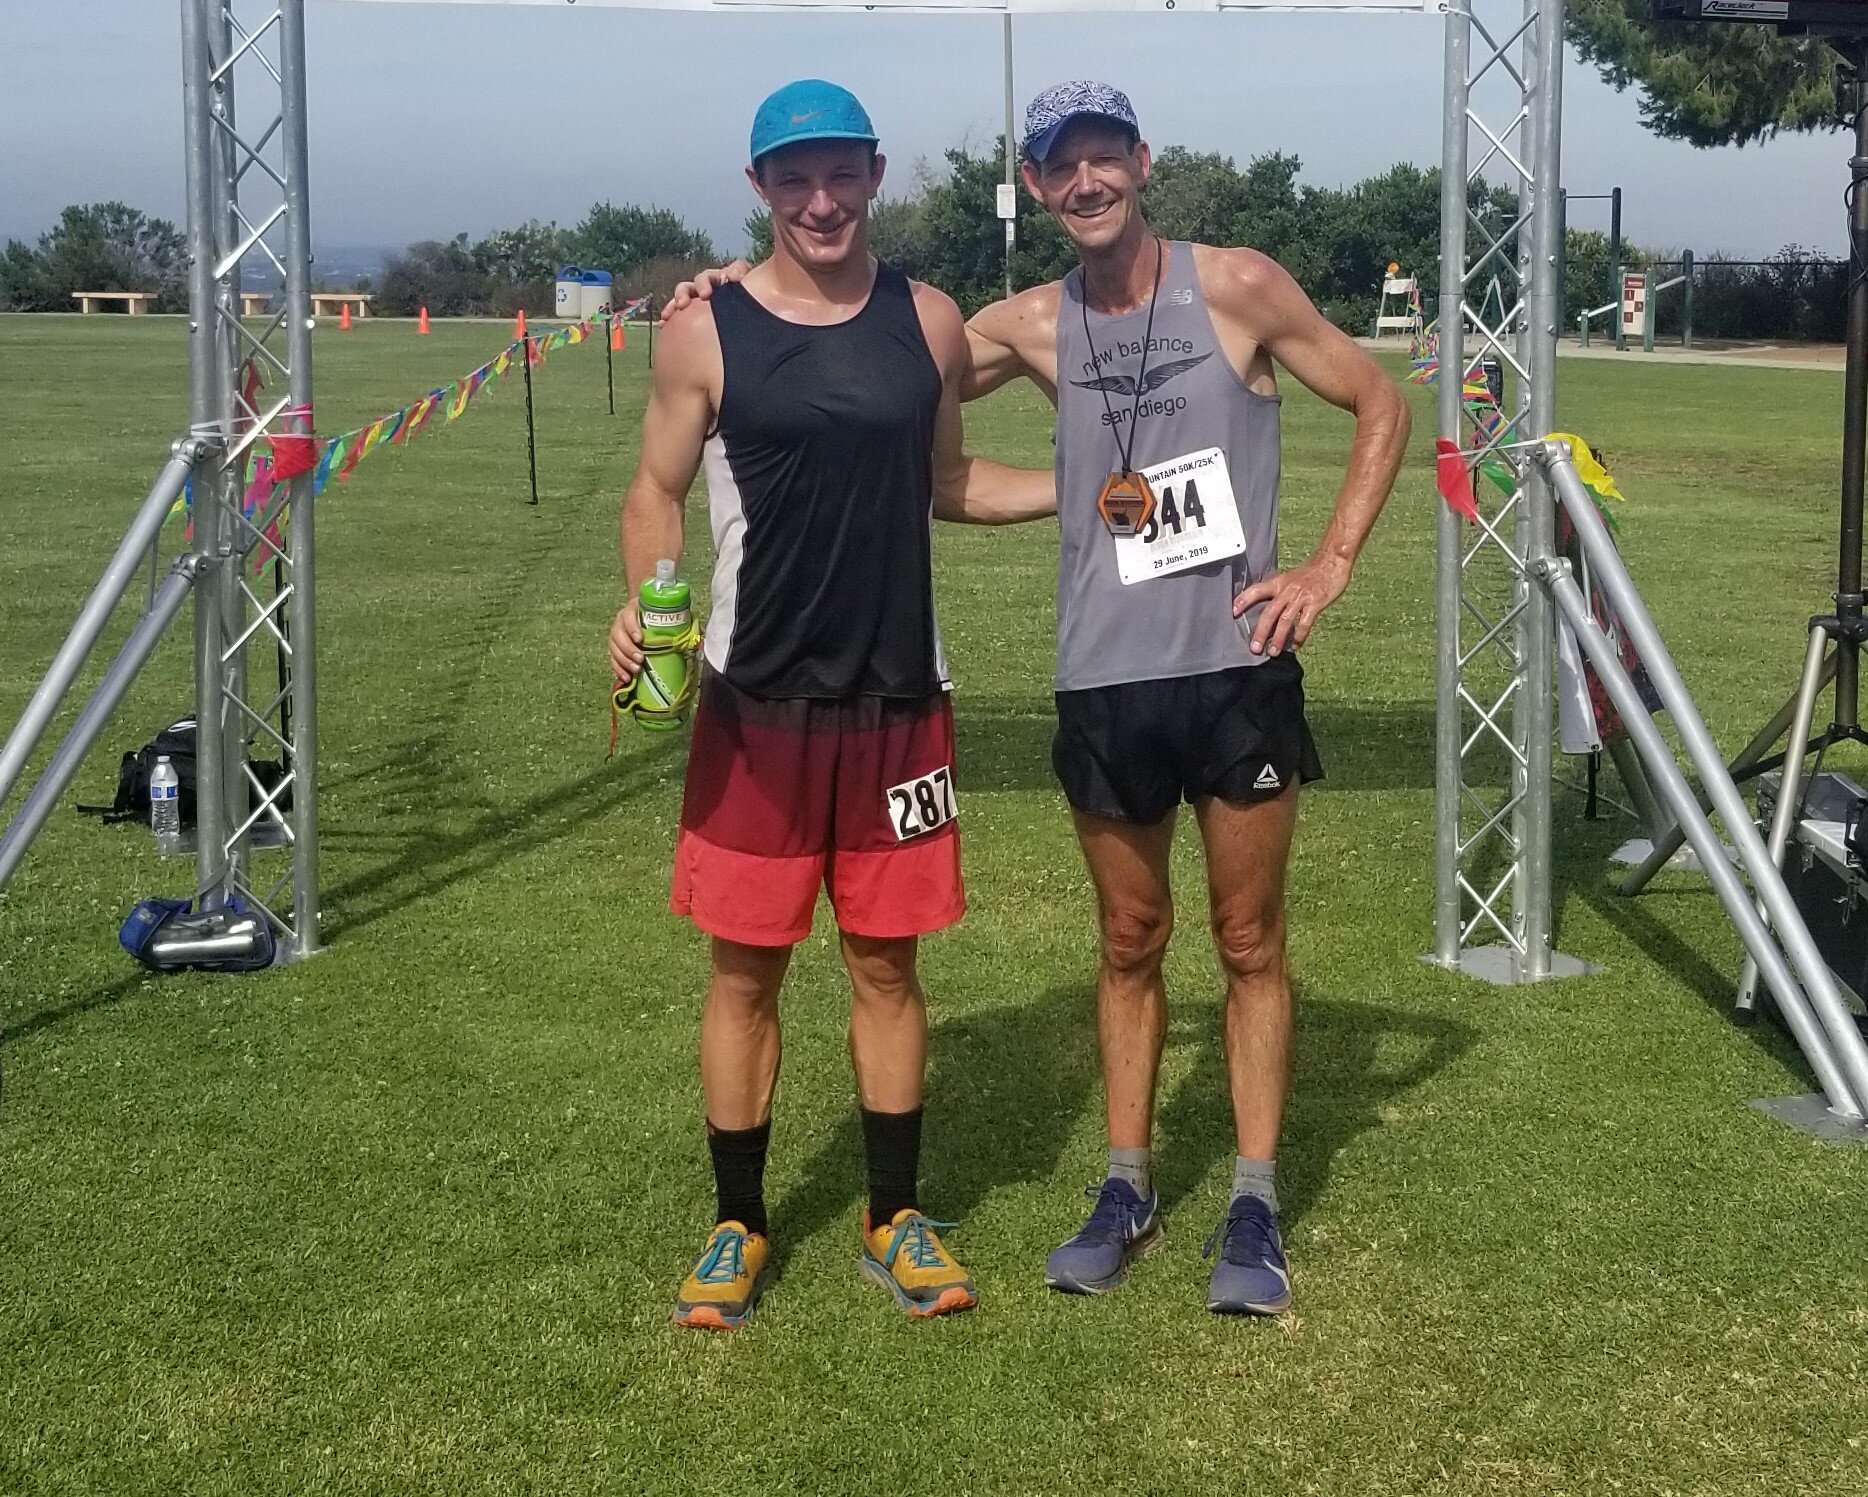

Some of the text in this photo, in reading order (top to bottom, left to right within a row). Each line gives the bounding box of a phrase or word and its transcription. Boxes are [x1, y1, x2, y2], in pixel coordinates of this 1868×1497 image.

[1082, 336, 1194, 376] new balance
[1101, 396, 1187, 427] san diego
[1148, 467, 1177, 484] UNTAIN
[1153, 545, 1209, 569] 29 June, 2019
[647, 613, 682, 623] ACTIVE
[889, 768, 952, 839] 287
